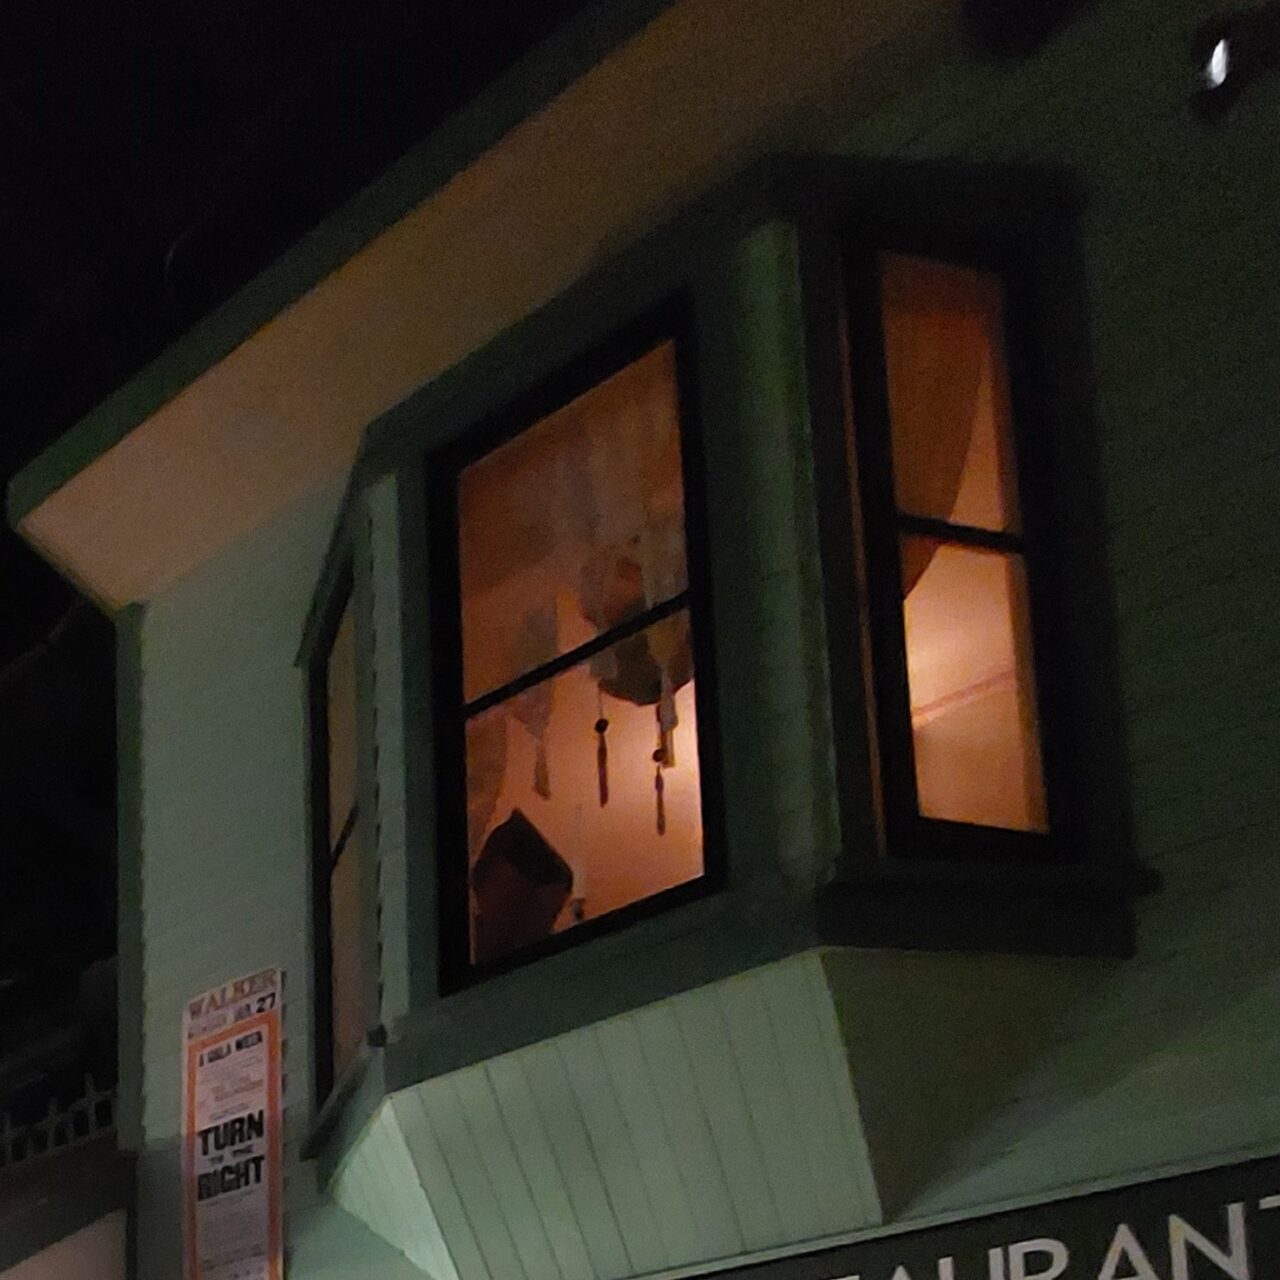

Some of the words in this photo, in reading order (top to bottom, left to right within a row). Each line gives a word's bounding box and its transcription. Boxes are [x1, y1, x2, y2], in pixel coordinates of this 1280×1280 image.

[256, 992, 276, 1013] 27
[197, 1109, 264, 1156] TURN
[197, 1155, 265, 1201] RIGHT
